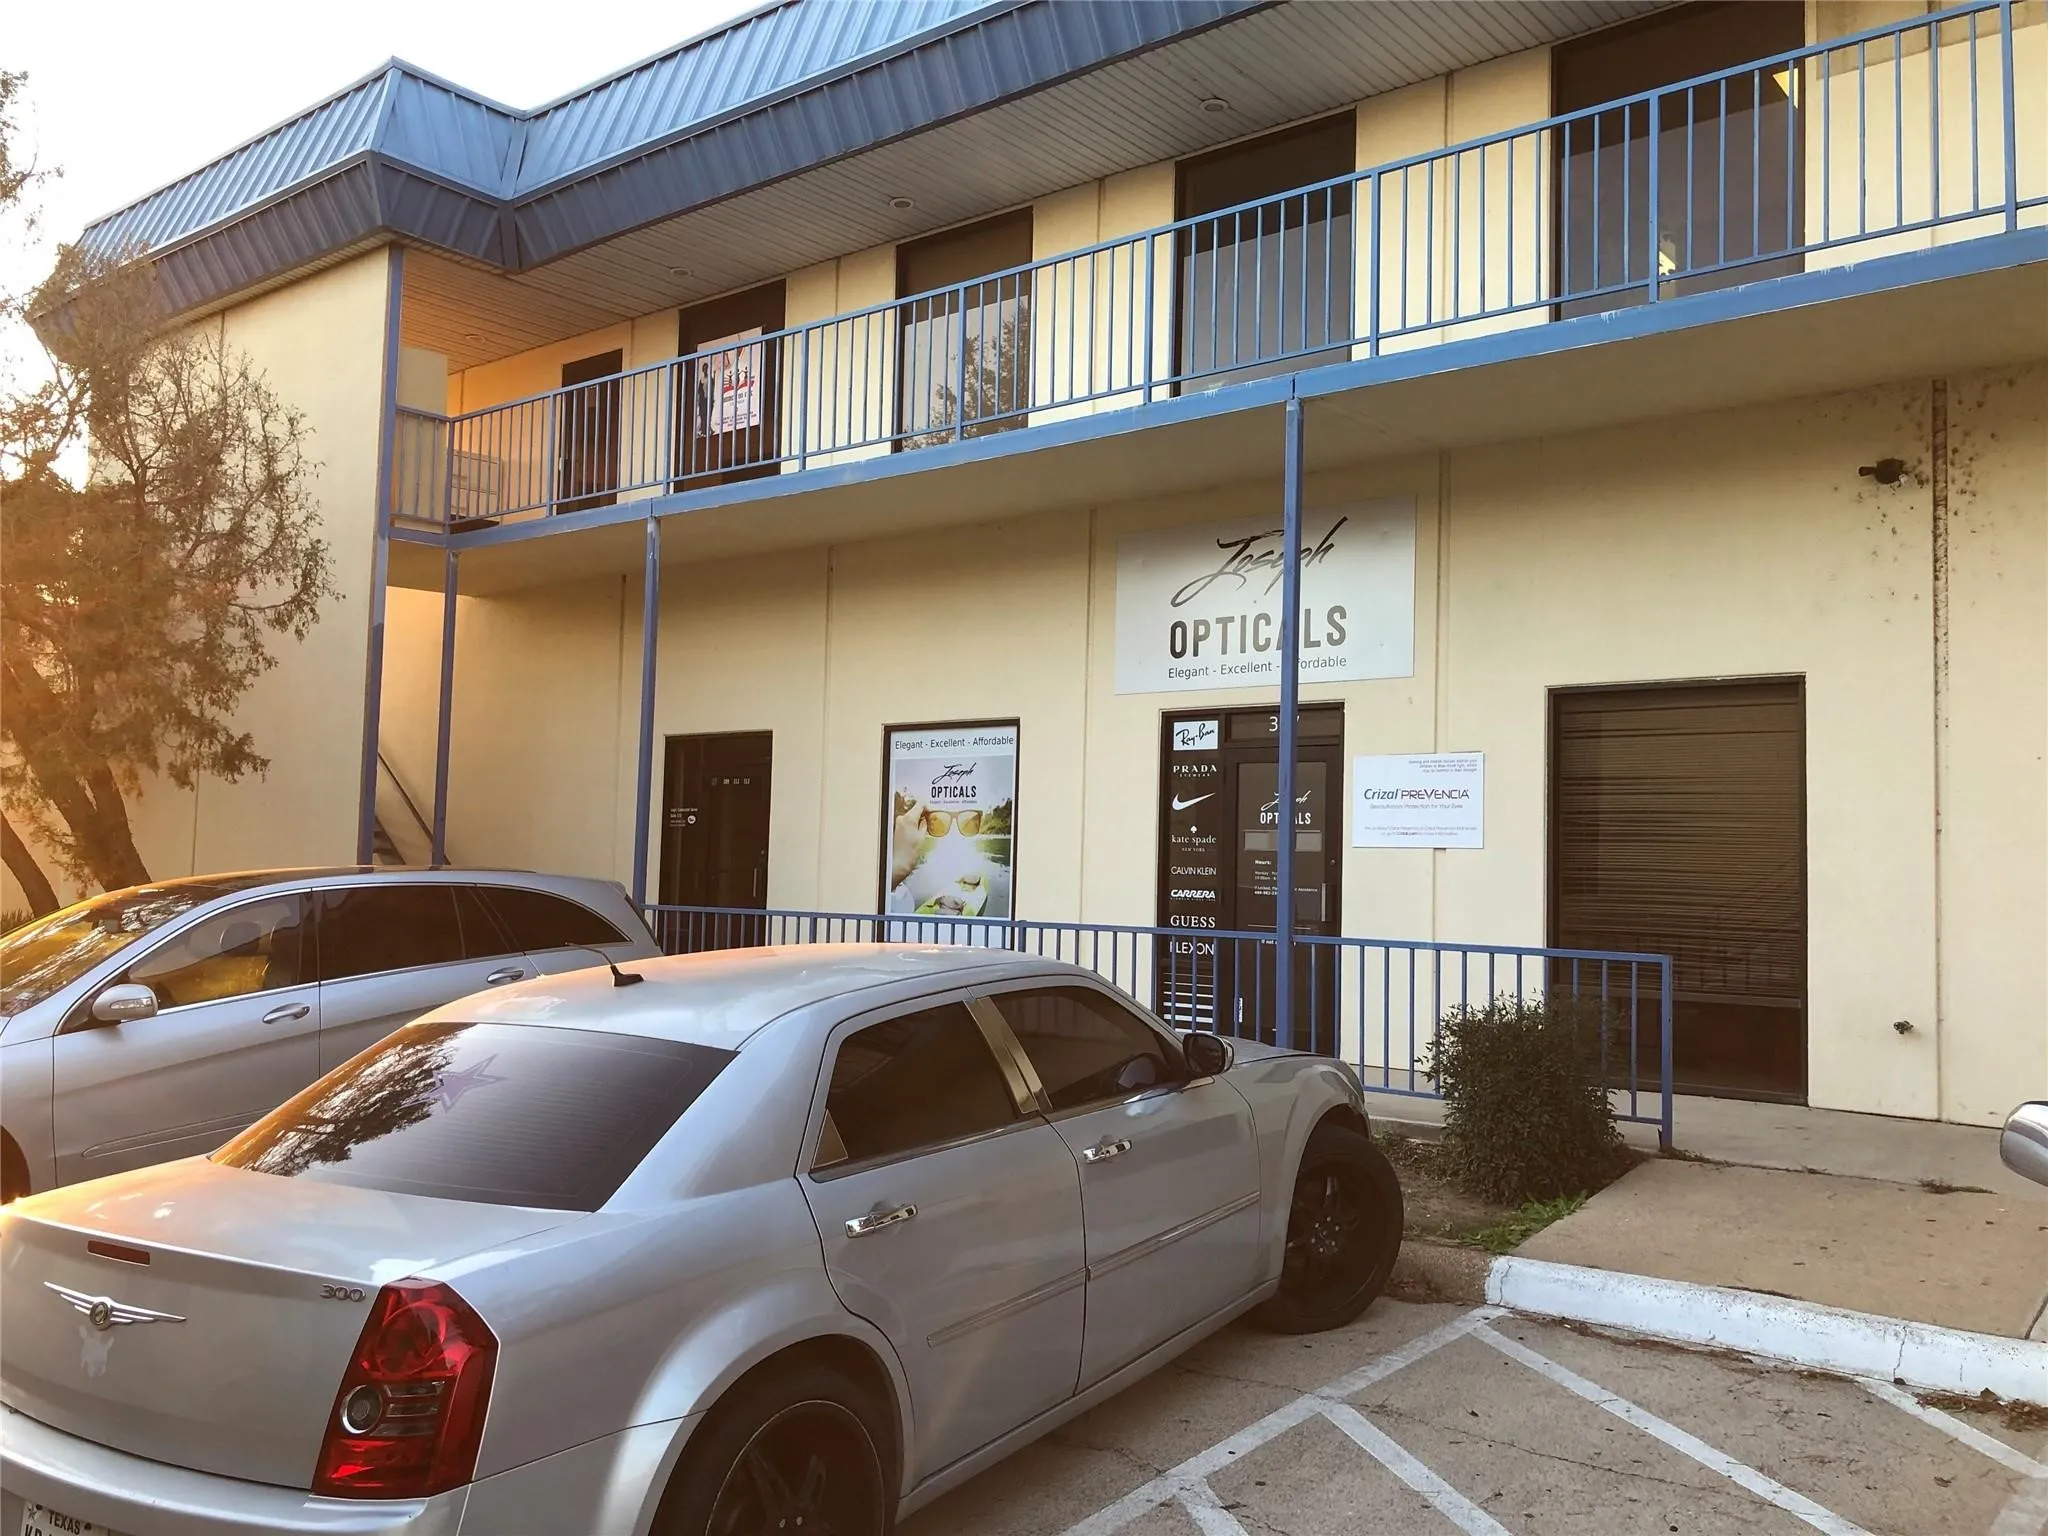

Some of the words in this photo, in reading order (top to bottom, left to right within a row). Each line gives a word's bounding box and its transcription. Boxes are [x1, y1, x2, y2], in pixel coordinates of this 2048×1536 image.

[1169, 605, 1347, 659] OPTICLS
[1168, 665, 1209, 680] Elegant
[1221, 661, 1273, 676] Excellent
[1175, 722, 1215, 746] Ray-Ban
[895, 740, 923, 750] Elegant
[930, 738, 965, 749] Excellent
[972, 735, 1014, 747] Affordable
[932, 762, 977, 784] Joseph
[1173, 764, 1217, 773] PRADA
[931, 785, 977, 799] OPTICALS
[1364, 788, 1399, 800] Crizal
[1400, 789, 1470, 800] PREVENCIA
[1260, 812, 1311, 825] OPTLS
[1171, 834, 1190, 843] kate
[1191, 834, 1217, 846] spade
[1170, 866, 1196, 875] CALVIN
[1197, 866, 1217, 876] KLEIN
[1170, 889, 1216, 899] CARRERA
[1170, 914, 1216, 929] GUESS
[320, 1283, 366, 1302] 300
[48, 1510, 81, 1535] TEXAS
